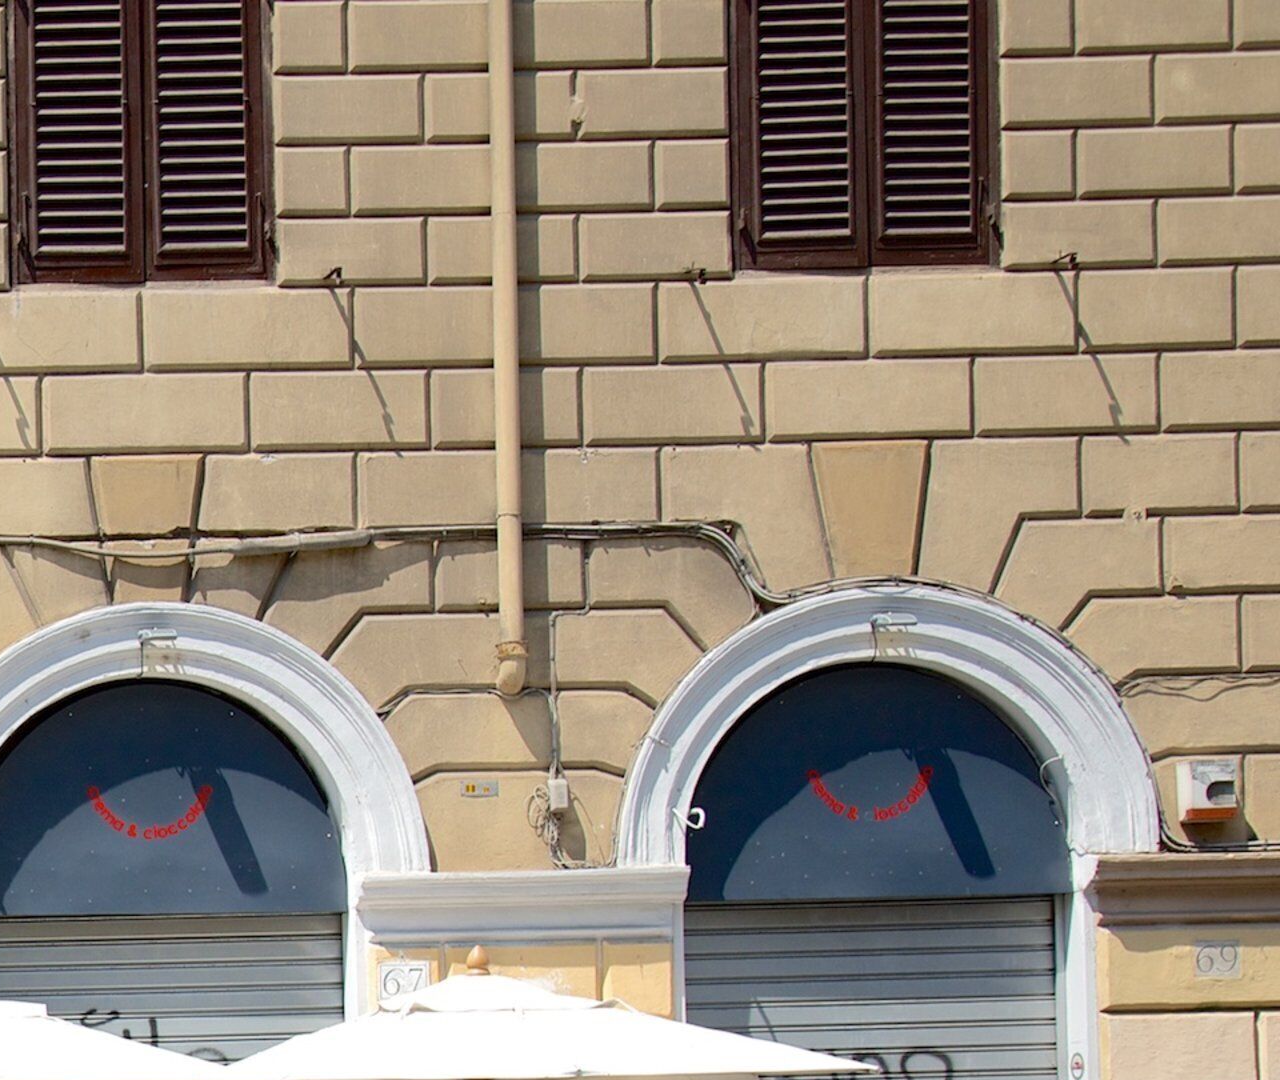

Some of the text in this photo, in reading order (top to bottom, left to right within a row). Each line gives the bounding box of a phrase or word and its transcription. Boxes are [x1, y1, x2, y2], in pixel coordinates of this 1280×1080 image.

[127, 823, 138, 838] &
[143, 784, 214, 840] cioccolato
[847, 806, 859, 821] &
[1196, 944, 1238, 973] 69
[383, 967, 423, 996] 67
